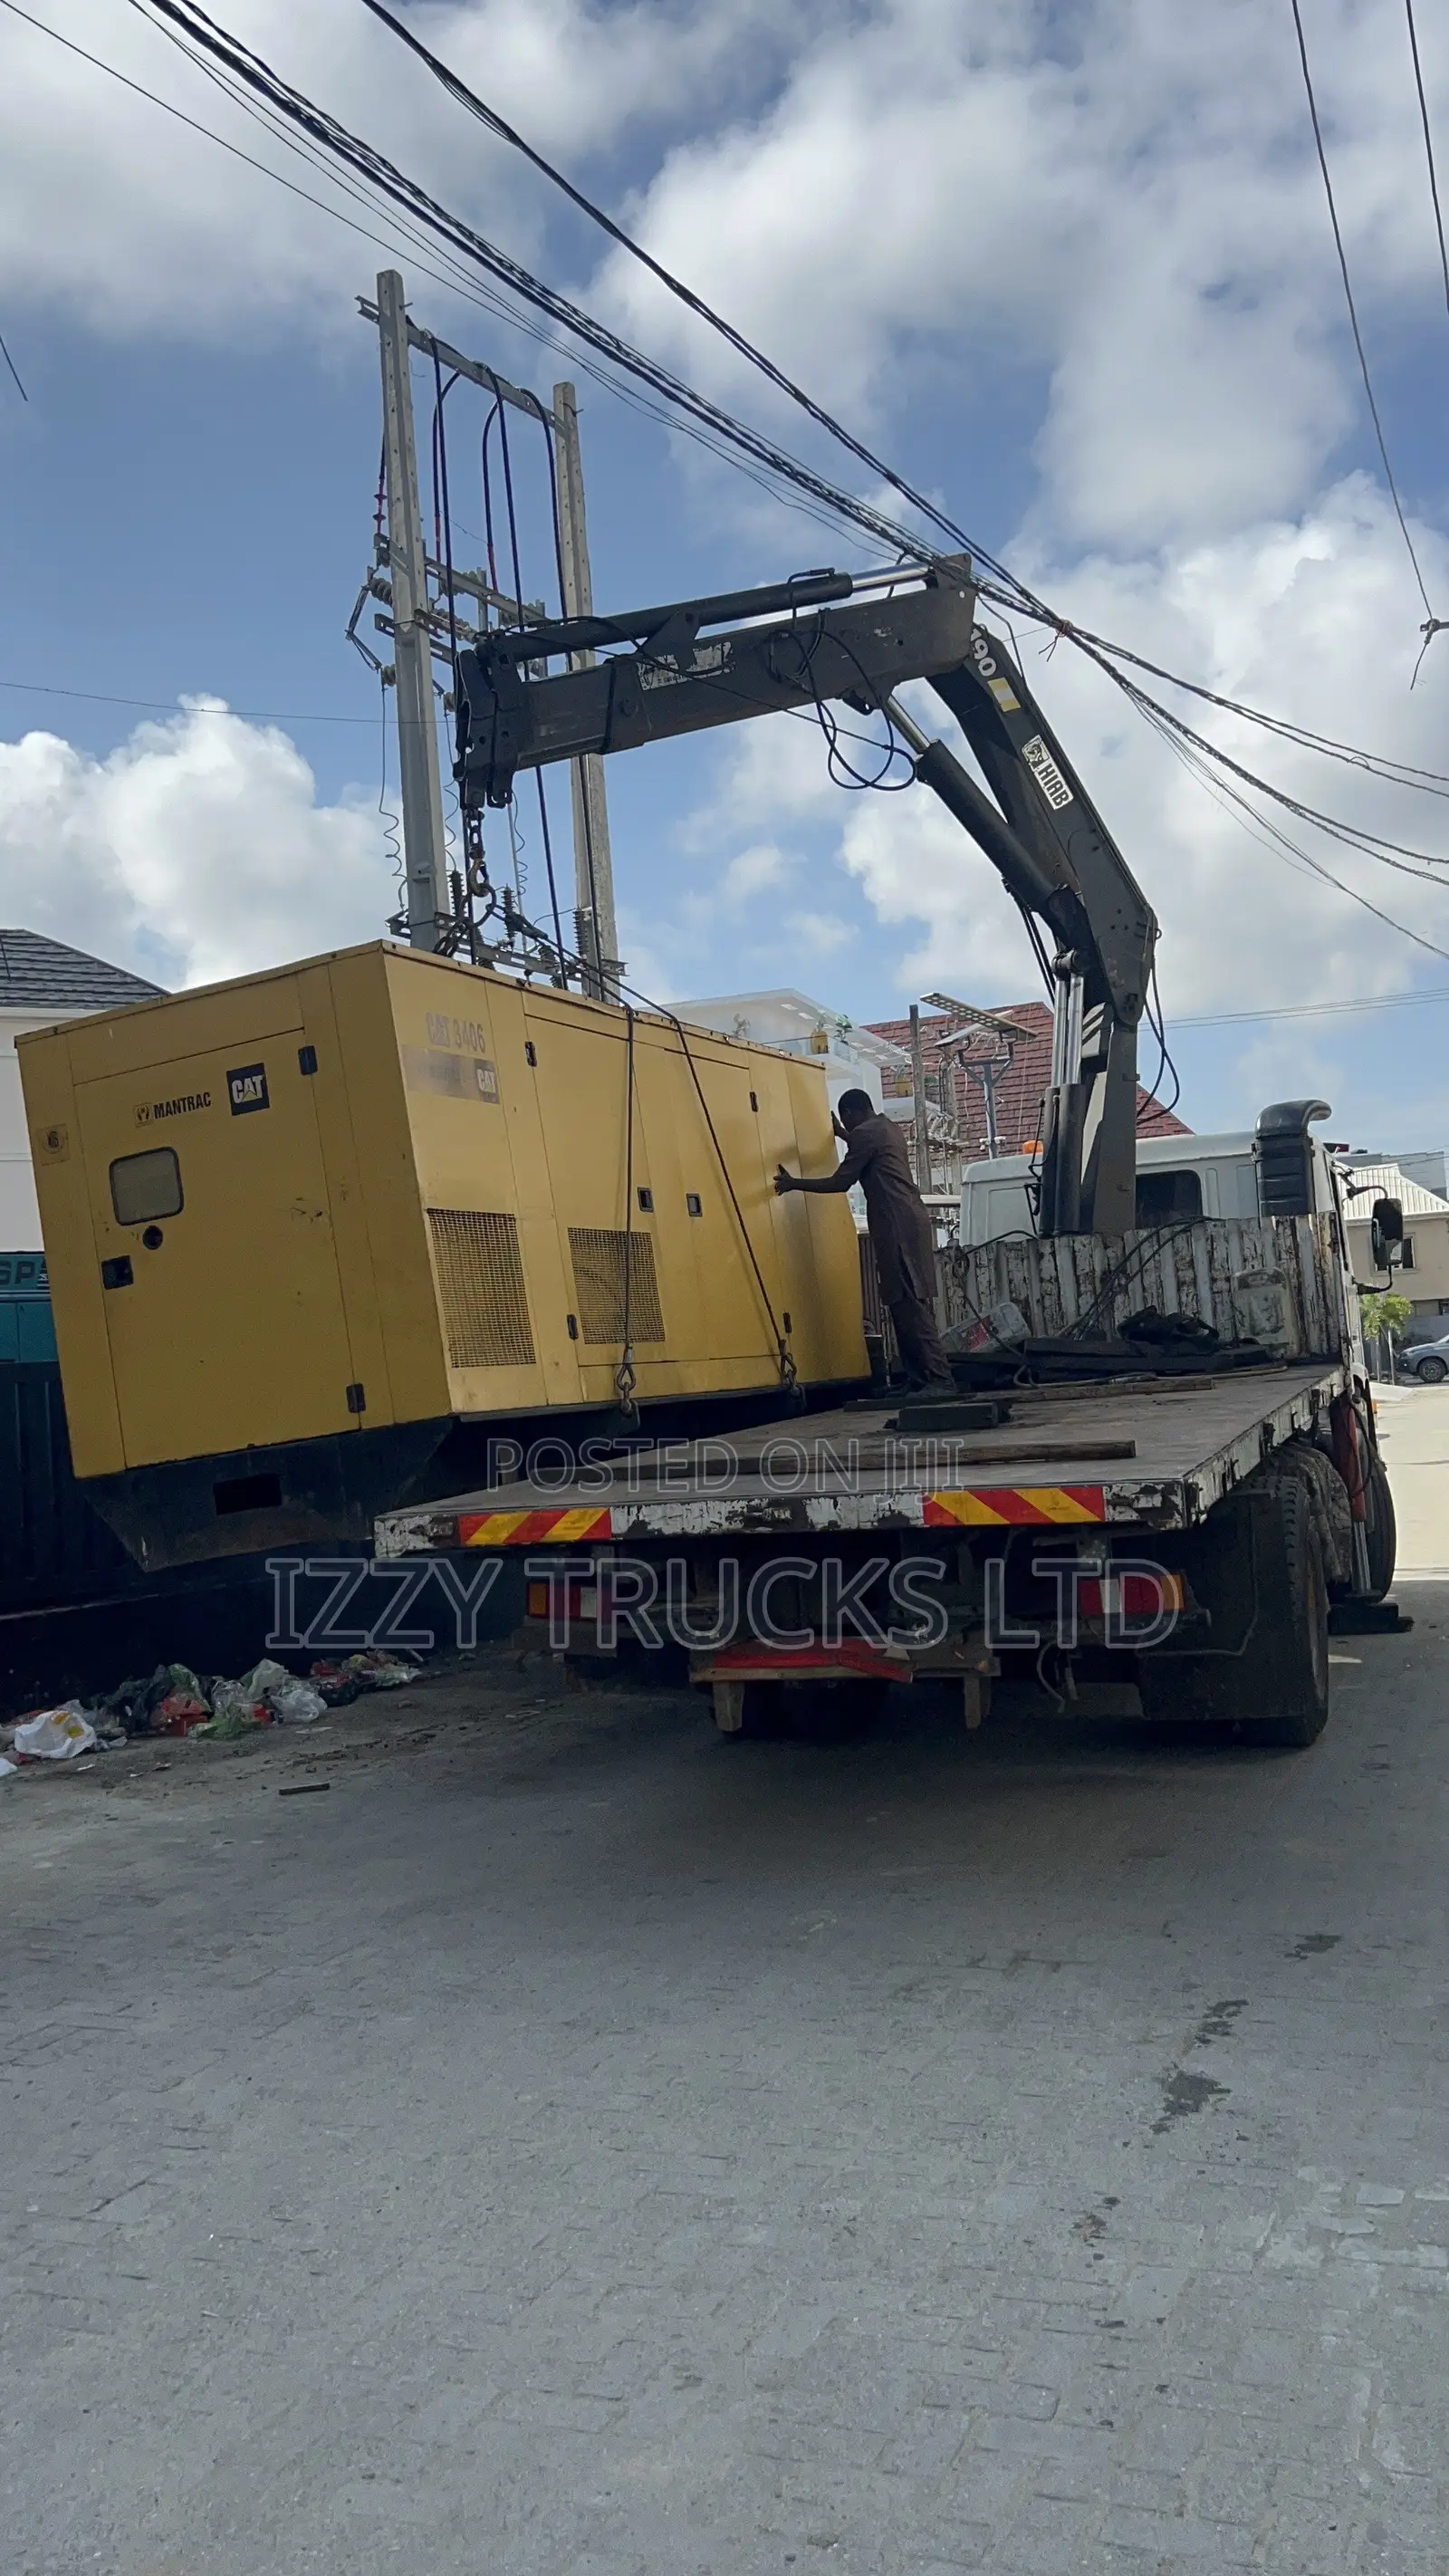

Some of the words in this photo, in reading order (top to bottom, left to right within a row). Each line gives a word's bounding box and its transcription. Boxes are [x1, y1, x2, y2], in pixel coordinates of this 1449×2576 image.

[1037, 763, 1070, 807] HIAB
[453, 1017, 486, 1054] 3406
[231, 1074, 264, 1104] CAT
[476, 1067, 497, 1094] CAT
[153, 1091, 212, 1120] MANTRAC
